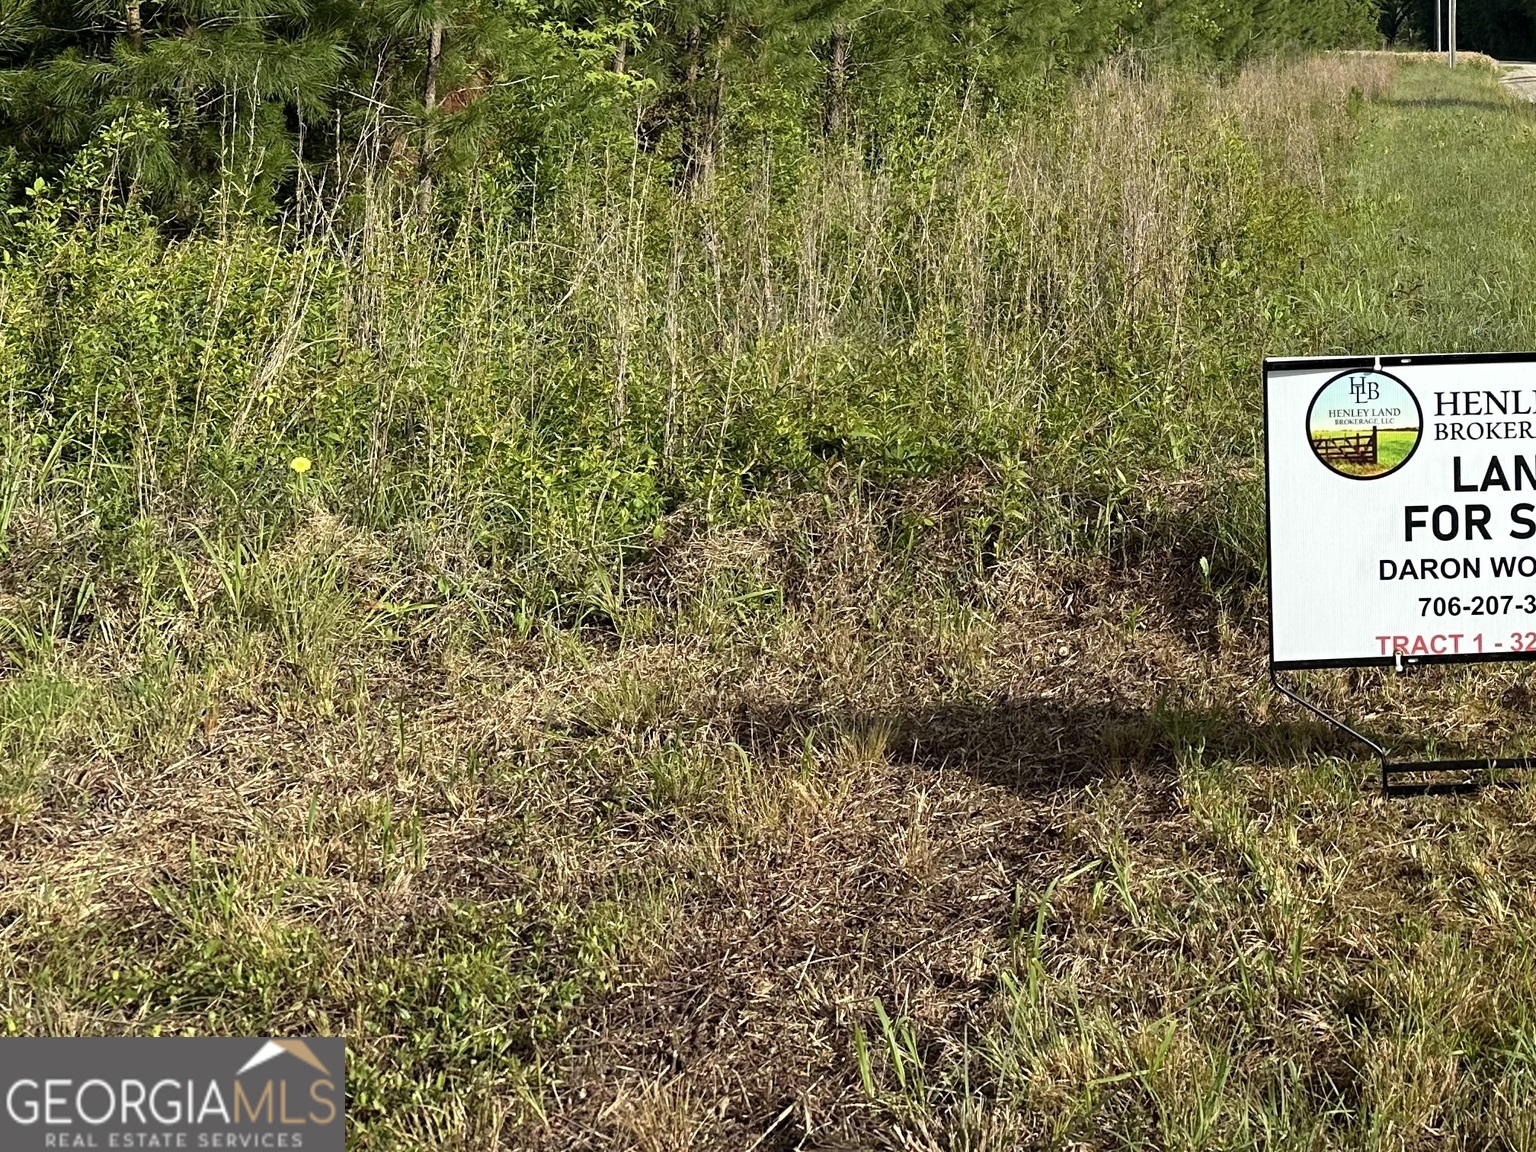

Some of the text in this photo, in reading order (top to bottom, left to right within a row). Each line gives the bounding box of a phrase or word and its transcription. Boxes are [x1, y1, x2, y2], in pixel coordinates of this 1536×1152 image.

[1328, 407, 1401, 418] HENLEY LAND
[1381, 417, 1395, 425] LLC
[1404, 503, 1493, 542] FOR
[1379, 557, 1481, 581] DARON
[1376, 633, 1465, 656] TRACT
[1473, 633, 1483, 654] 1
